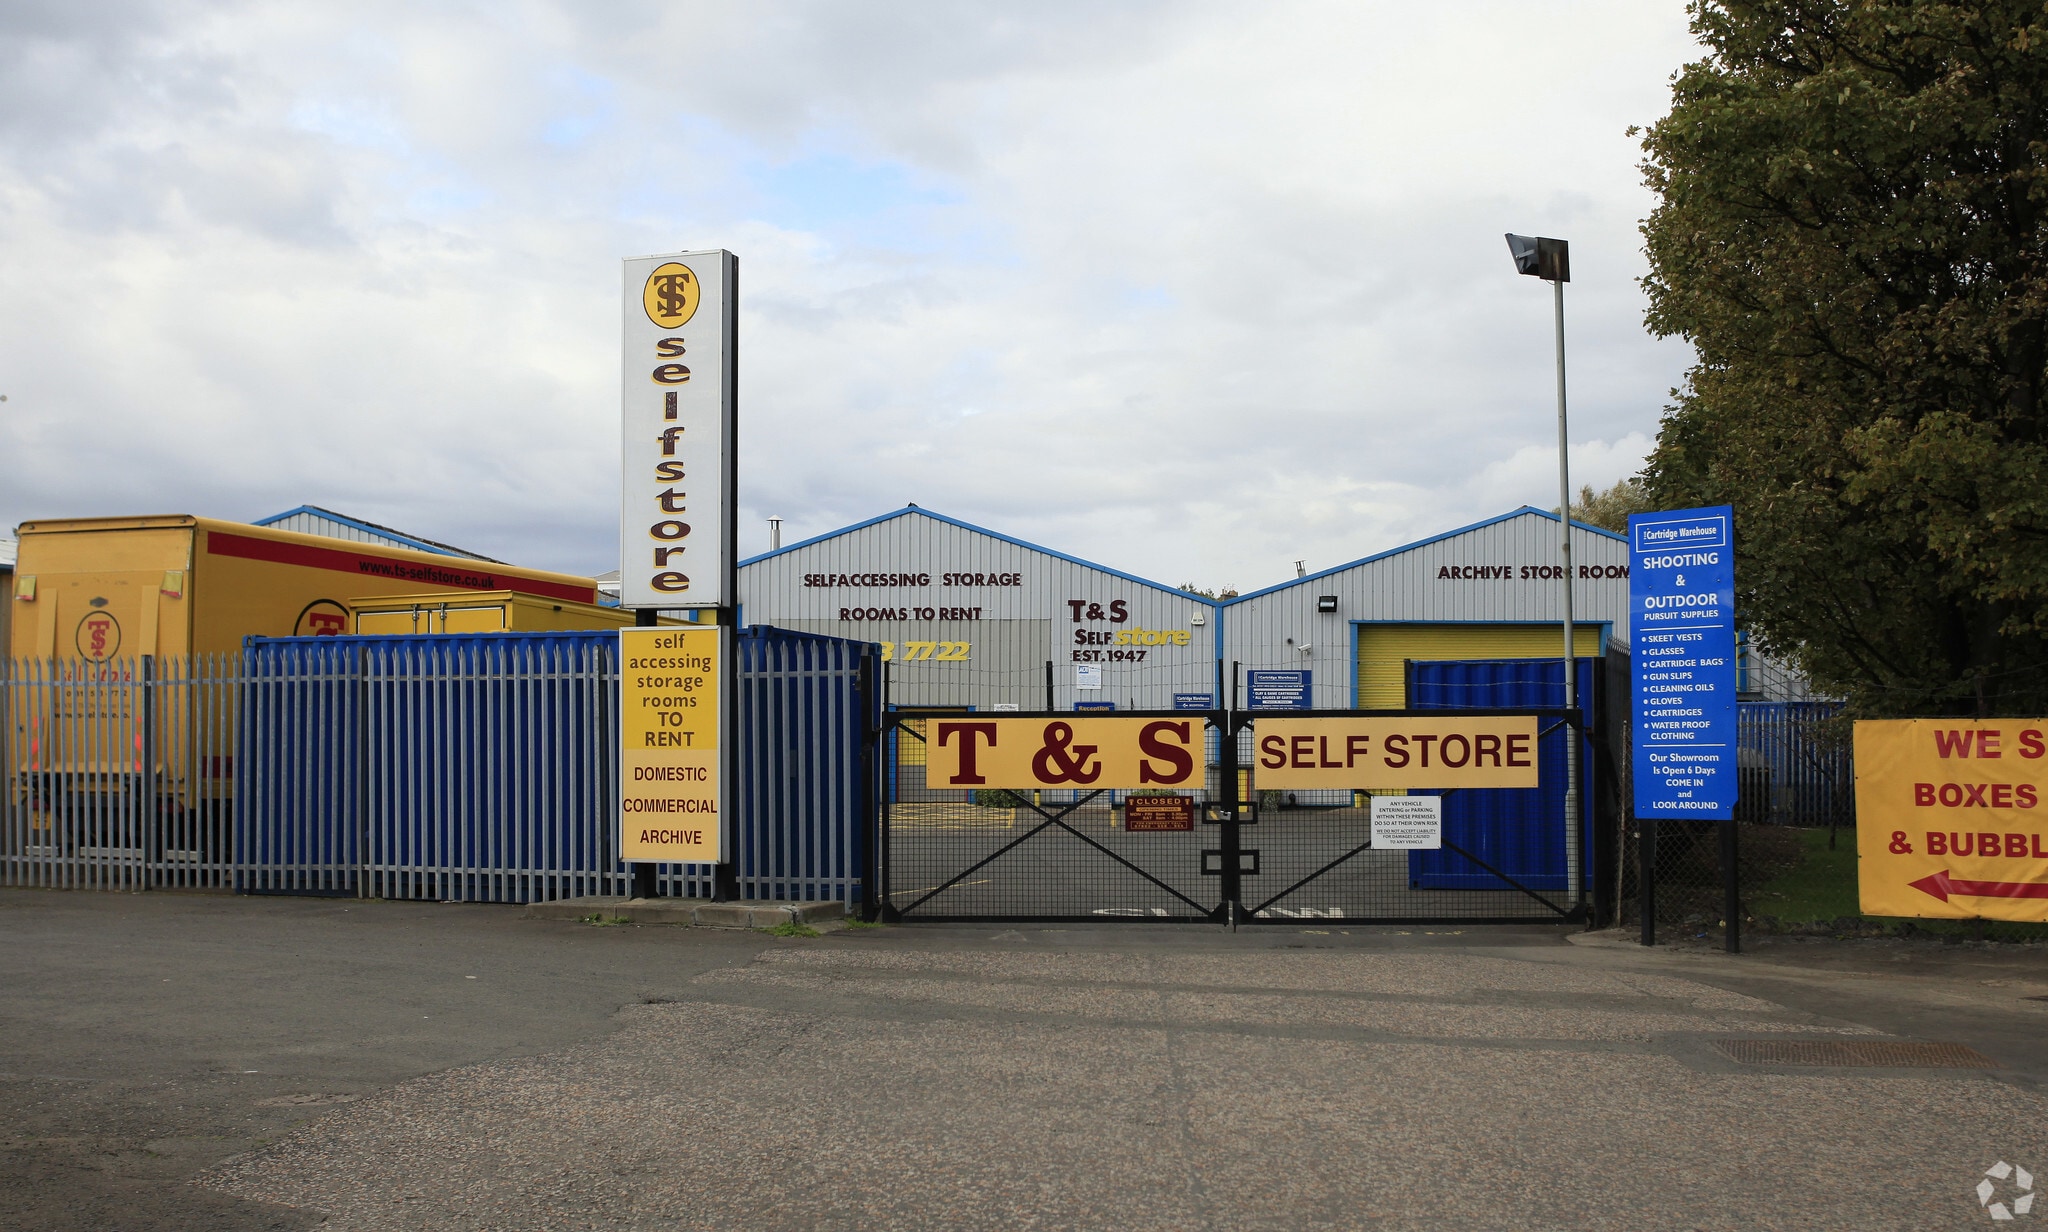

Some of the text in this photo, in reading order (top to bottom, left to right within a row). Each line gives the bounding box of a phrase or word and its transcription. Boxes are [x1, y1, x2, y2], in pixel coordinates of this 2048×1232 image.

[649, 335, 691, 593] selfstore
[1646, 529, 1678, 540] Cartridge
[1679, 526, 1716, 537] Warehouse
[1644, 553, 1718, 570] SHOOTING
[359, 560, 494, 588] www.ts-selfstore.co.uk
[804, 572, 1021, 587] SELFACCESSING STORAGE
[1438, 566, 1512, 579] ARCHIVE
[1521, 566, 1573, 579] STOR
[1676, 574, 1685, 586] &
[1645, 594, 1718, 609] OUTDOOR
[840, 606, 982, 621] ROOMS TO RENT
[1644, 609, 1718, 621] PURSUIT SUPPLIES
[654, 634, 685, 649] self
[1113, 626, 1191, 646] store
[1648, 633, 1702, 642] SKEET VESTS
[903, 642, 970, 661] 7722
[1072, 649, 1146, 662] EST.1947
[1649, 647, 1685, 656] GLASSES
[630, 654, 711, 672] accessing
[1649, 658, 1723, 668] CARTRIDGE BAGS
[1649, 672, 1668, 680] GUN
[637, 675, 703, 692] storage
[1650, 683, 1714, 693] CLEANING OILS
[643, 696, 696, 707] rooms
[1650, 697, 1682, 705] GLOVES
[658, 711, 683, 727] TO
[1650, 708, 1702, 717] CARTRIDGES
[645, 732, 694, 747] RENT
[1651, 732, 1695, 740] CLOTHING
[1934, 729, 2045, 759] WE S
[938, 721, 1193, 785] T & S
[1260, 734, 1531, 769] SELF STORE
[1649, 753, 1719, 762] Our Showroom
[634, 767, 707, 781] DOMESTIC
[1653, 766, 1716, 776] Is Open 6 Days
[1666, 778, 1703, 787] COME IN
[1678, 790, 1692, 798] and
[1914, 783, 2038, 808] BOXES
[623, 798, 717, 813] COMMERCIAL
[1653, 801, 1718, 809] LOOK AROUND
[640, 830, 702, 844] ARCHIVE
[1888, 831, 2048, 858] & BUBBL
